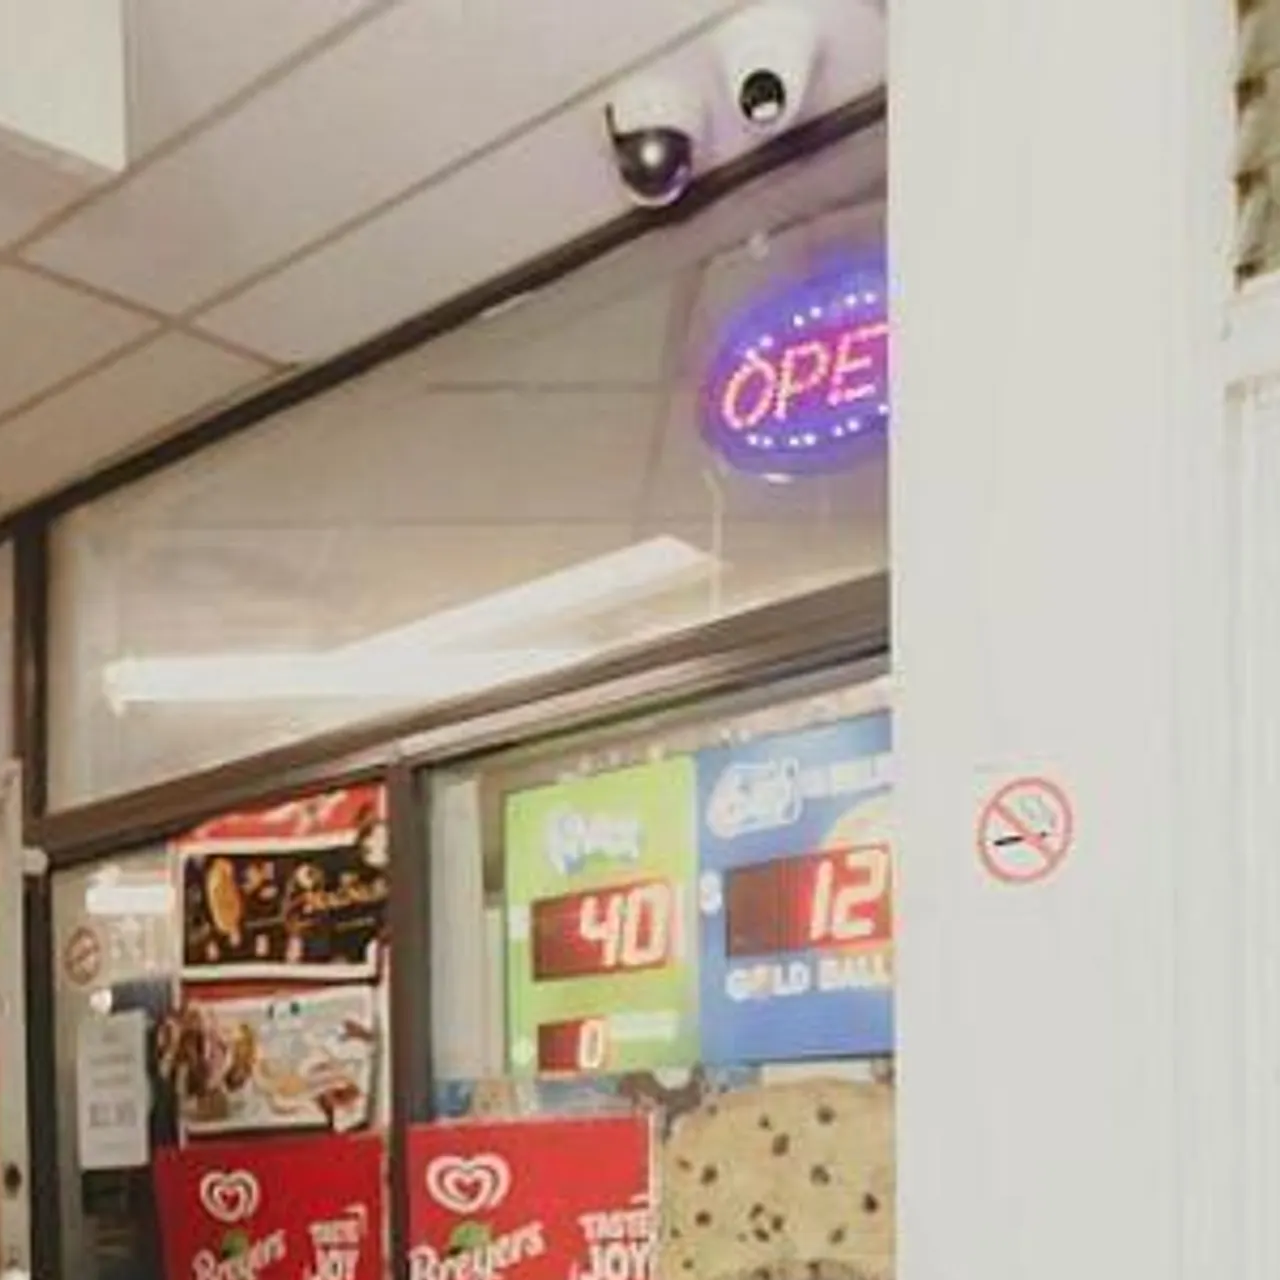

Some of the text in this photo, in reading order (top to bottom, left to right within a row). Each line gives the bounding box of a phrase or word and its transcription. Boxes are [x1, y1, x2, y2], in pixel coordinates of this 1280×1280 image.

[723, 322, 898, 430] OPE
[580, 882, 670, 967] 40
[810, 850, 888, 941] 12
[726, 962, 809, 1000] GOLD
